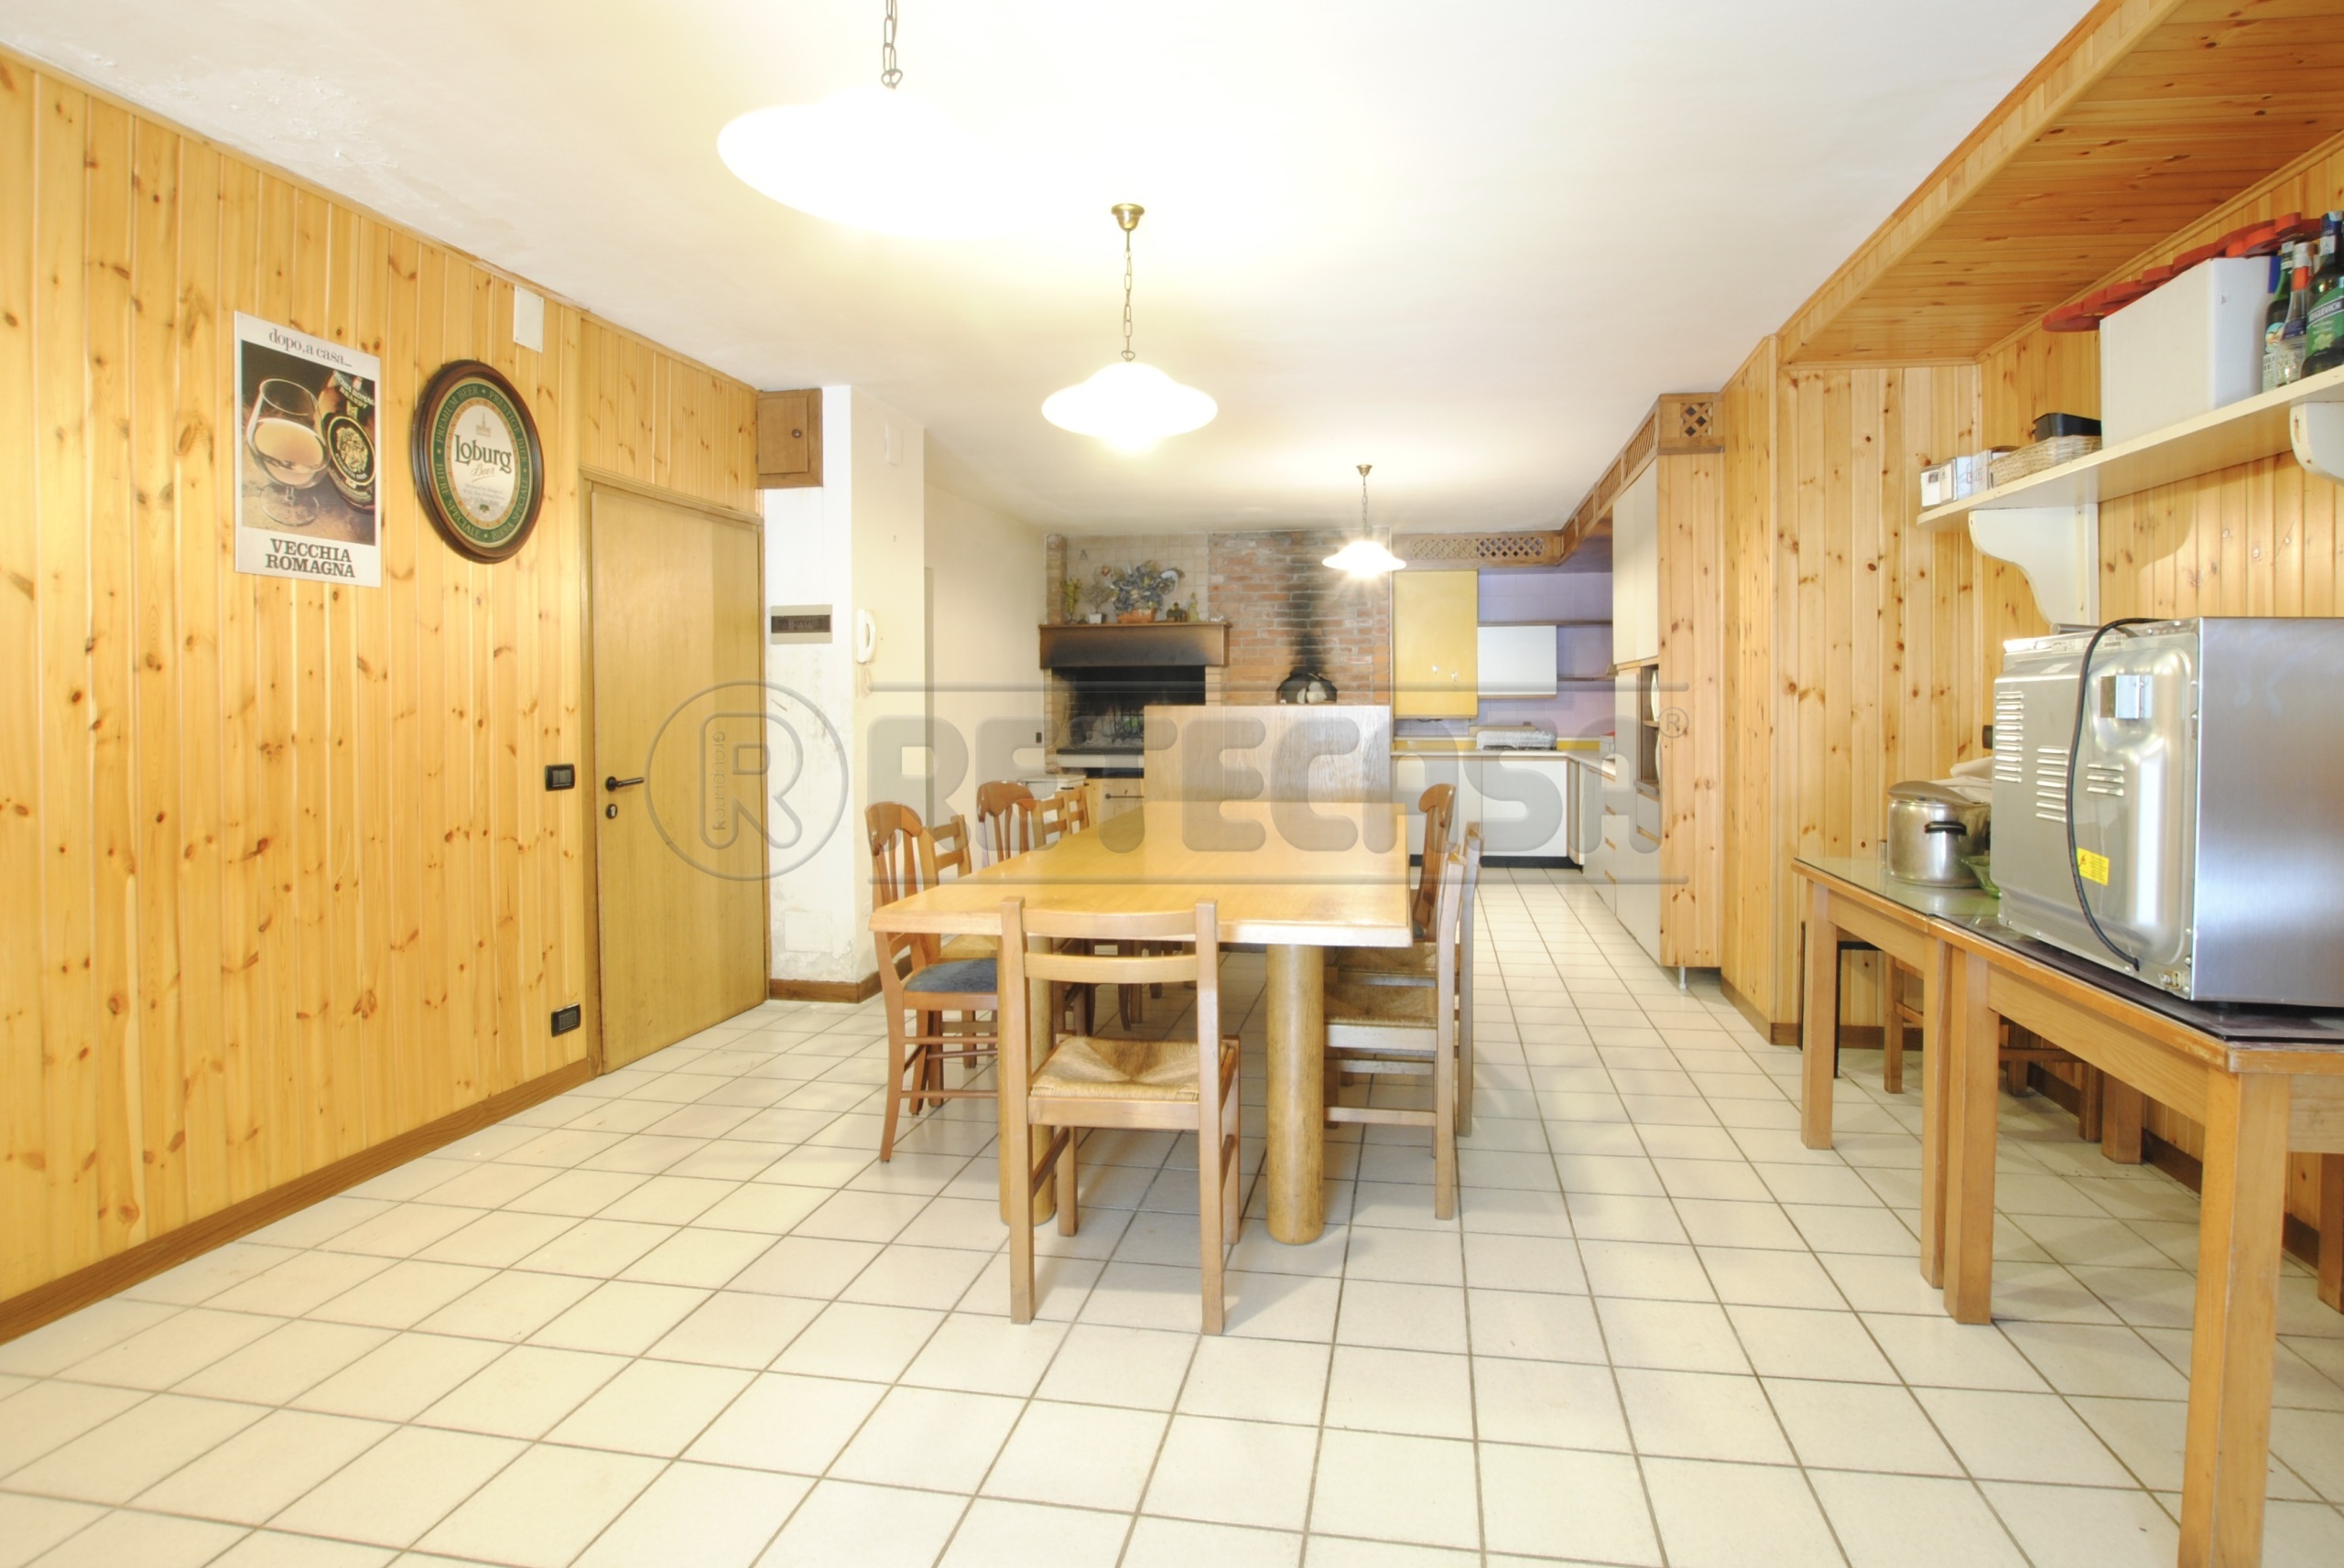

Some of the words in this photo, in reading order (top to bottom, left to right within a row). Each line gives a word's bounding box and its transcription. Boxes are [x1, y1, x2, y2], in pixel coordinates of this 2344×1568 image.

[436, 396, 459, 444] PREMIUM
[458, 385, 478, 400] BEER
[454, 434, 512, 474] Loburg
[447, 499, 481, 538] SPECIALE
[266, 554, 356, 578] ROMAGNA
[270, 538, 353, 563] VECCHIA
